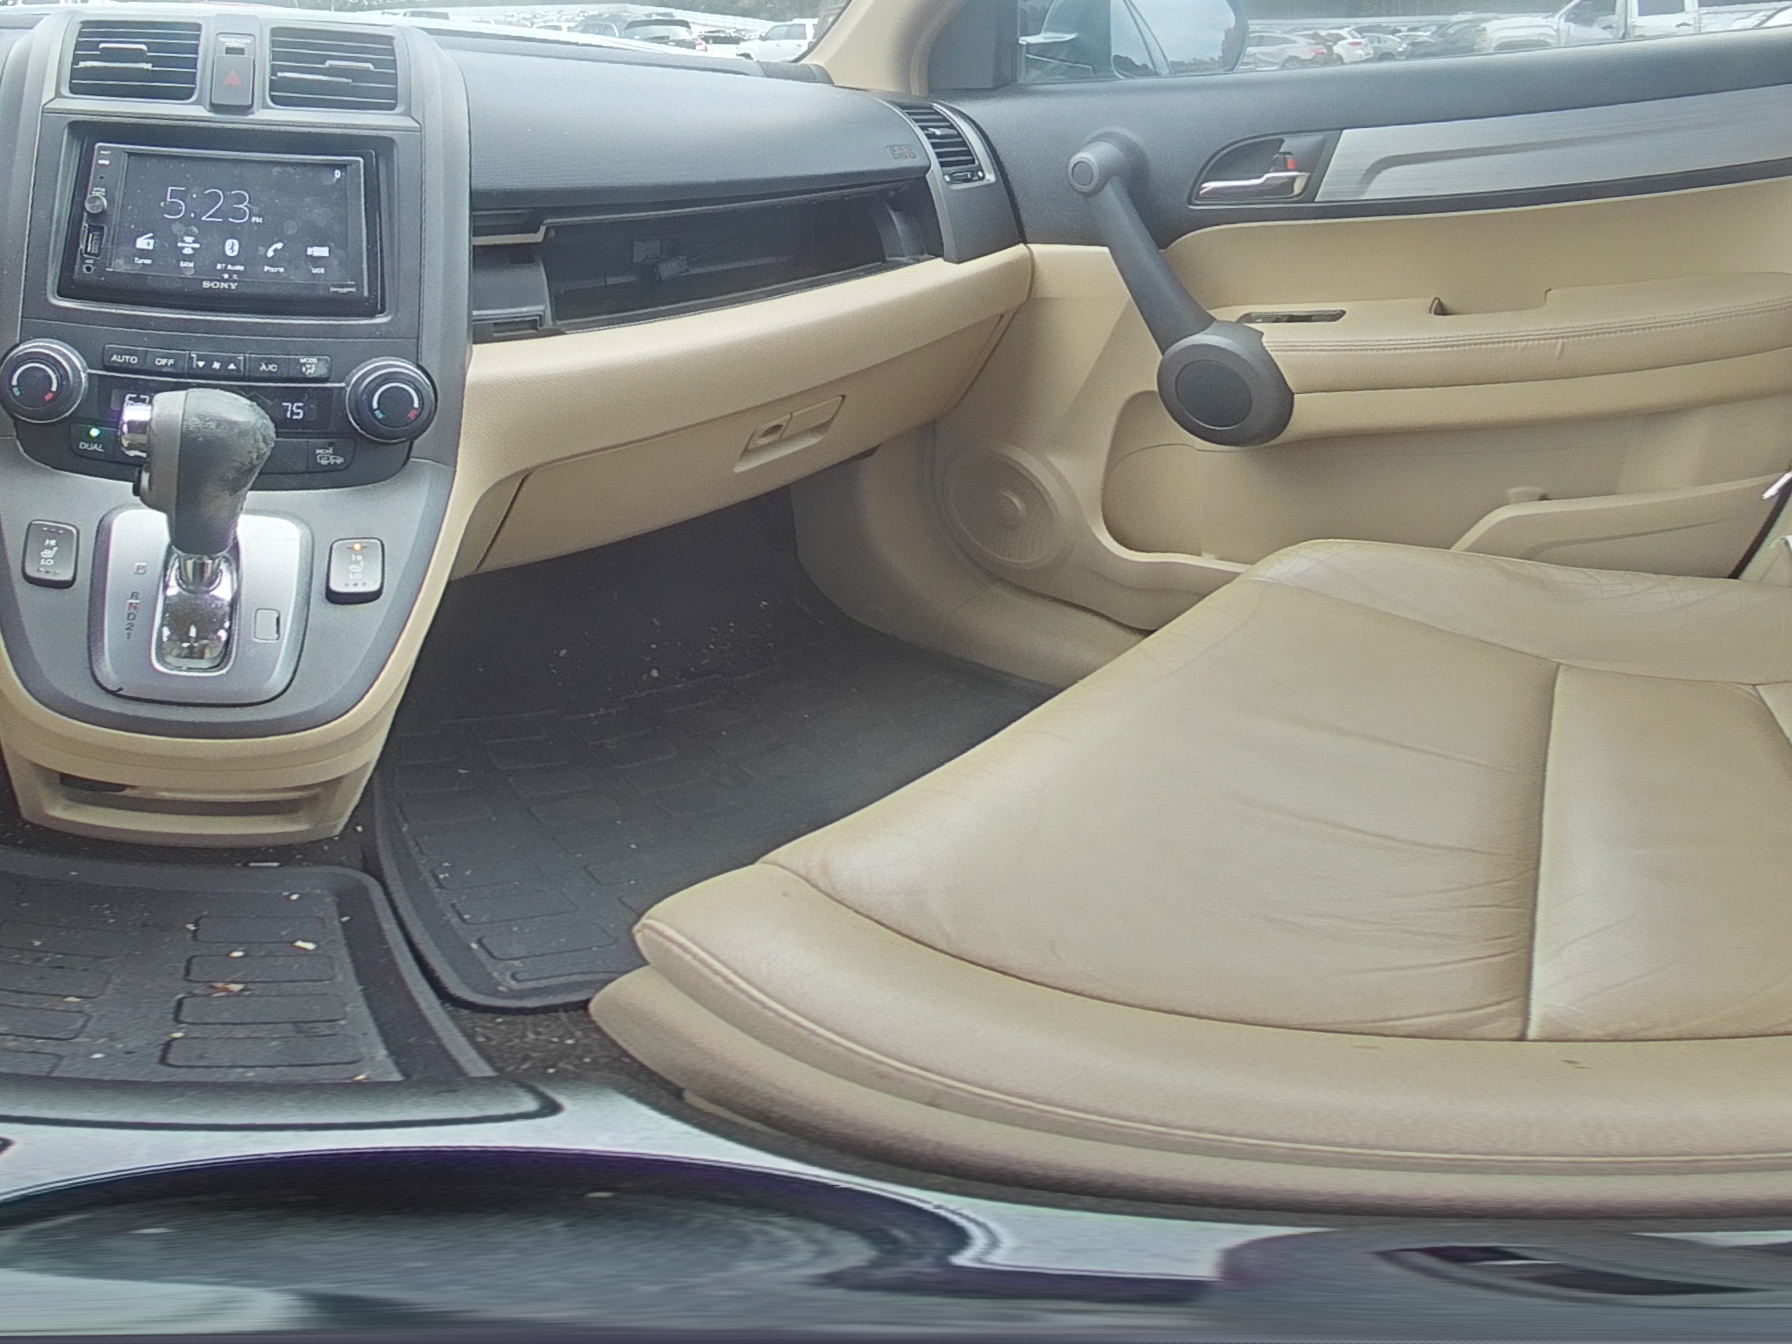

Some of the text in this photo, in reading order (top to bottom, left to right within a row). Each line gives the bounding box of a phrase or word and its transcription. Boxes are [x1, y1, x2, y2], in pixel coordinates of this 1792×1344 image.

[162, 186, 251, 224] 5:23
[263, 265, 285, 273] Phone
[201, 280, 238, 290] SONY
[111, 354, 139, 364] AUTO
[154, 357, 176, 367] OFF
[259, 362, 279, 373] A/C
[281, 401, 305, 420] 75
[78, 441, 106, 453] DUAL
